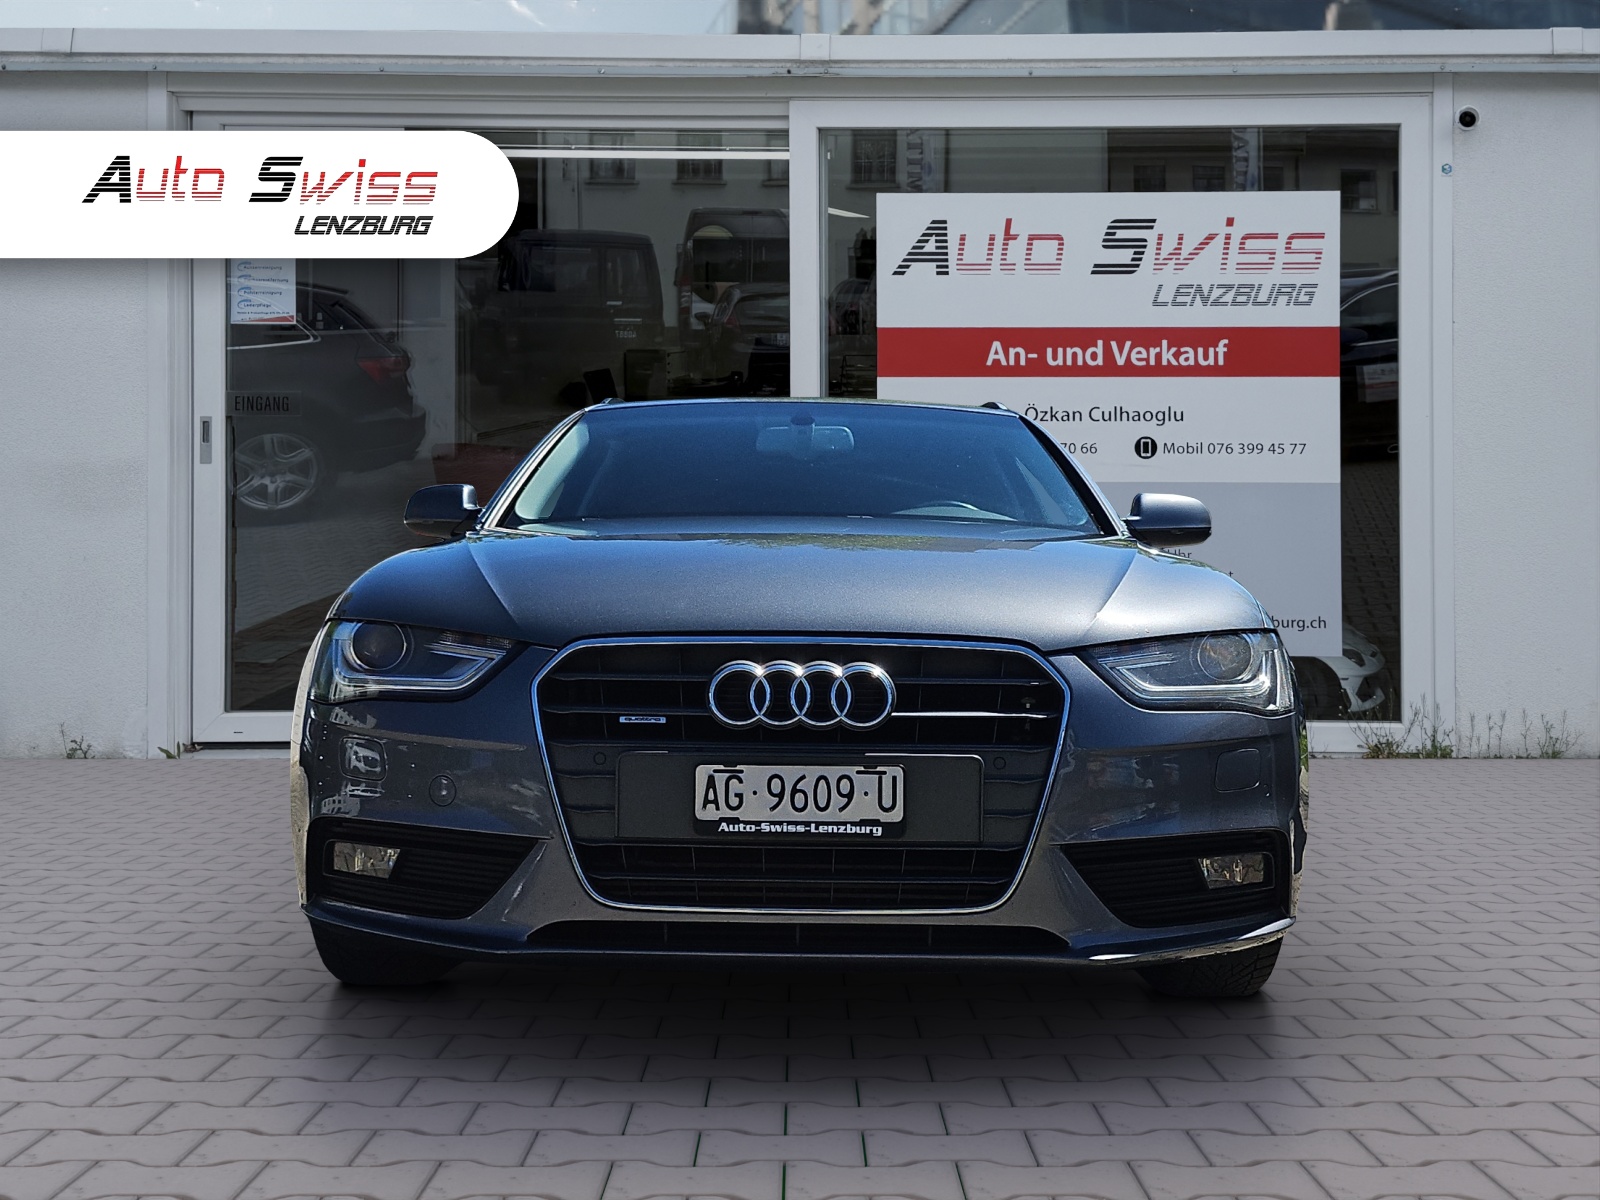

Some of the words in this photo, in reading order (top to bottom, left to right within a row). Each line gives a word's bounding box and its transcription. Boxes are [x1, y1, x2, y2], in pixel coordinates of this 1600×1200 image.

[892, 218, 1064, 276] Auto
[1090, 217, 1325, 275] Swiss
[1152, 284, 1318, 306] LENZBURG
[986, 340, 1038, 366] An-
[1046, 339, 1103, 366] und
[1110, 339, 1228, 366] Verkauf
[234, 395, 289, 411] EINGANG
[1025, 404, 1082, 422] Özkan
[1089, 405, 1184, 426] Culhaoglu
[1080, 442, 1098, 454] 66
[1163, 441, 1203, 454] Mobil
[1208, 442, 1233, 454] 076
[1238, 442, 1264, 454] 399
[1268, 442, 1285, 454] 45
[1290, 442, 1307, 454] 77
[1272, 615, 1327, 632] burg.ch
[718, 822, 883, 838] Auto-Swiss-Lenzburg
